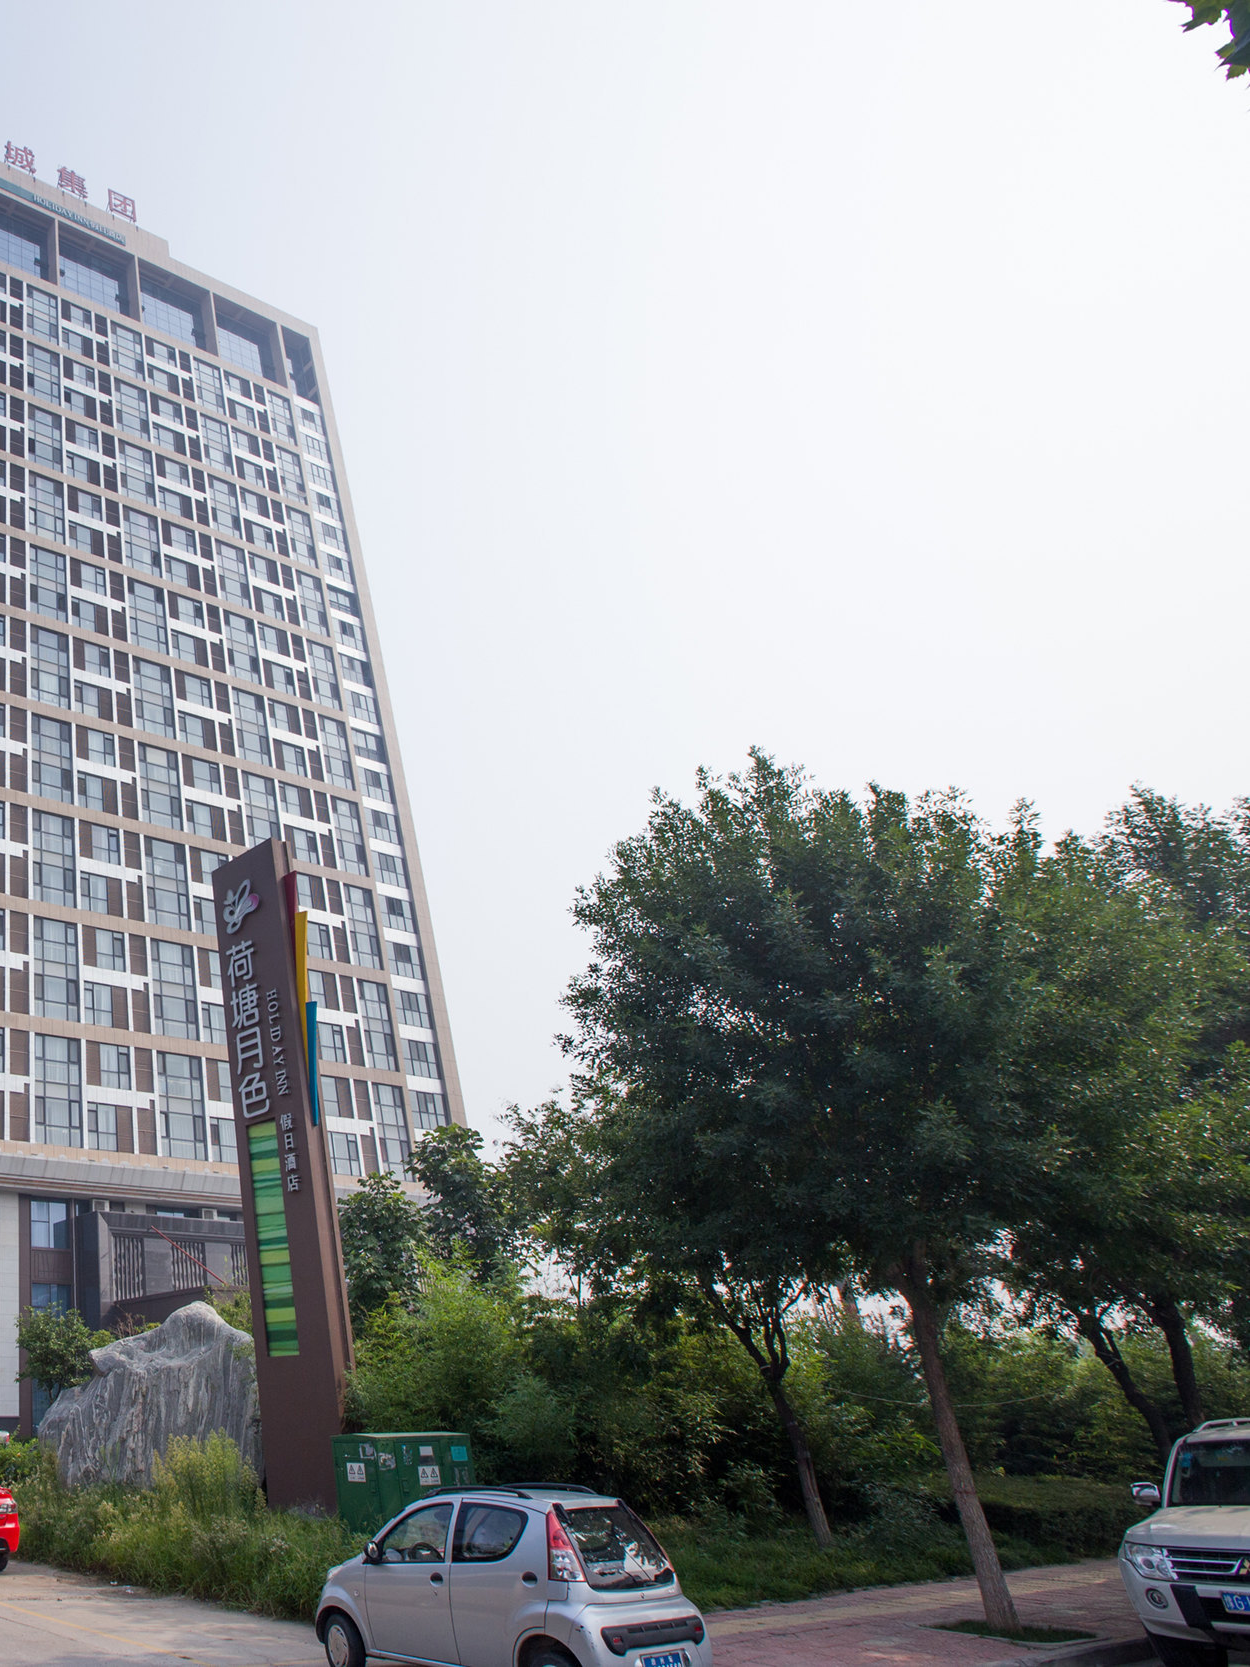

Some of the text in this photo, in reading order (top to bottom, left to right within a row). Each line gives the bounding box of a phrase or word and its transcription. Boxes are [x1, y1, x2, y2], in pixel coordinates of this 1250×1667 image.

[33, 193, 74, 217] HOLIDAY
[225, 940, 270, 1119] 荷塘月色
[266, 987, 289, 1096] HOLIDAY INN
[280, 1113, 301, 1193] 假日酒店
